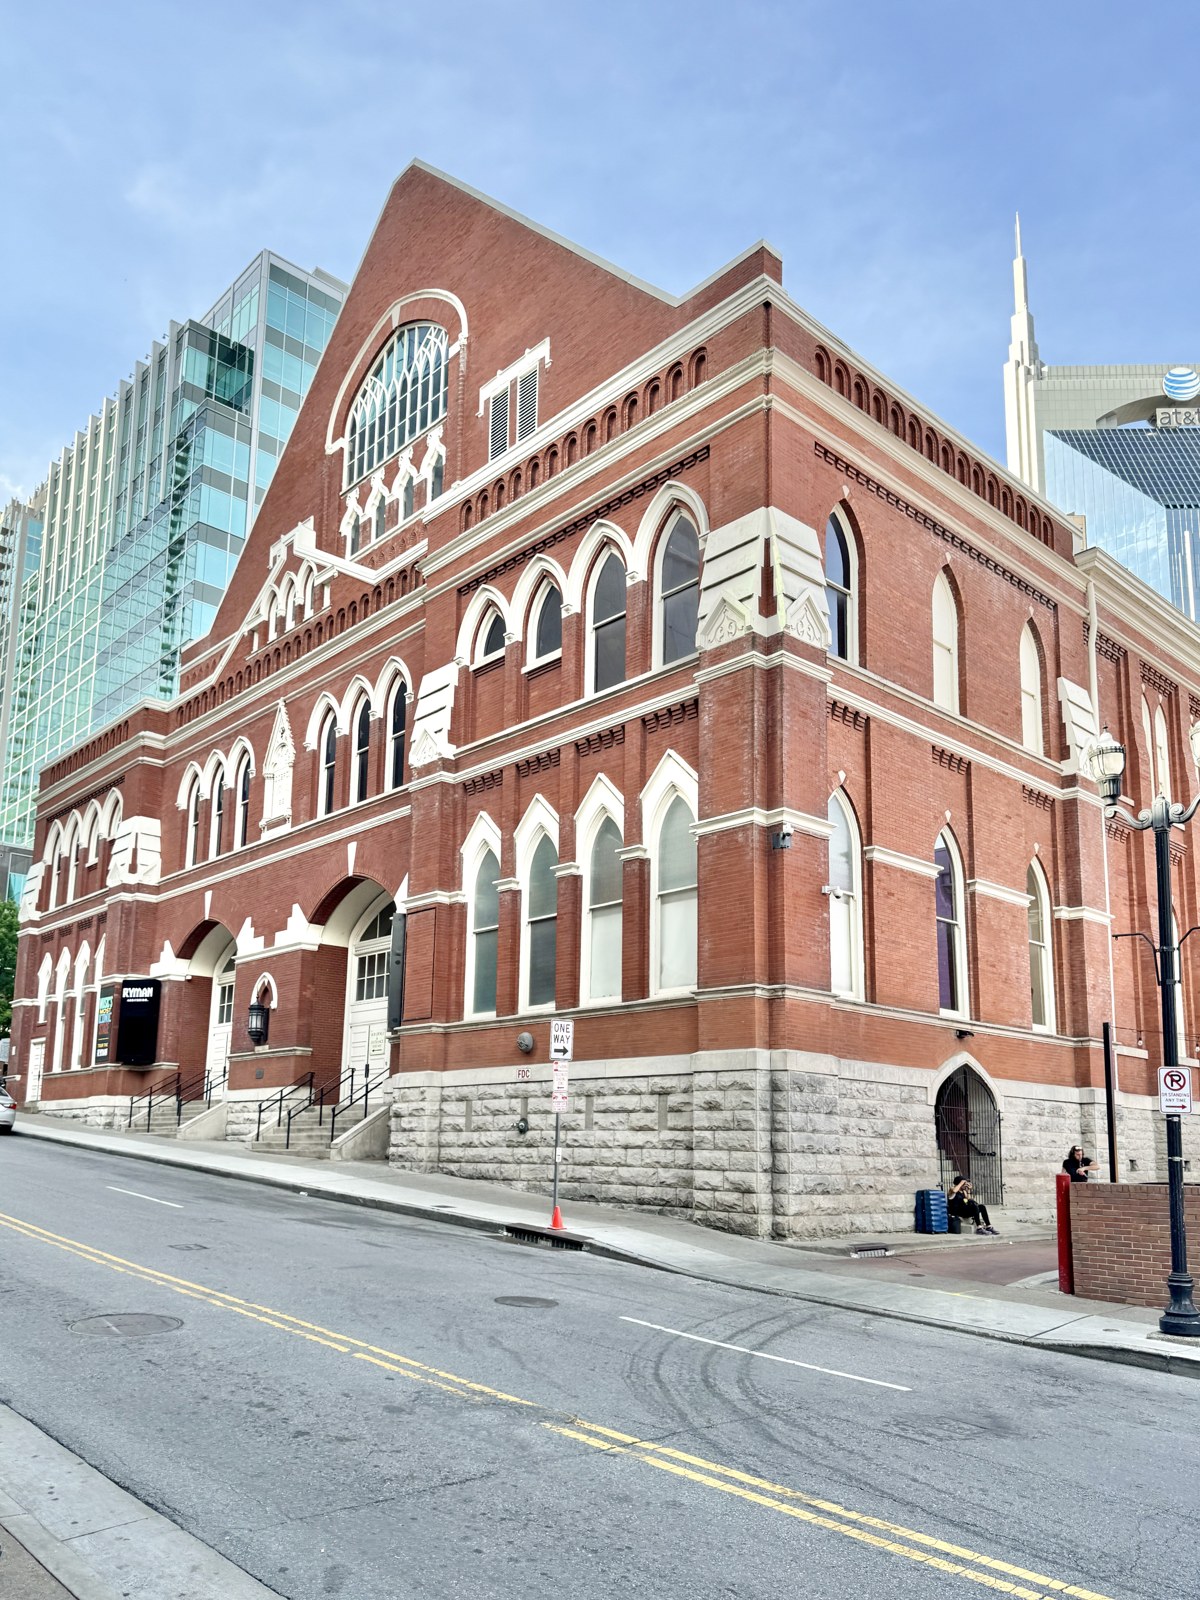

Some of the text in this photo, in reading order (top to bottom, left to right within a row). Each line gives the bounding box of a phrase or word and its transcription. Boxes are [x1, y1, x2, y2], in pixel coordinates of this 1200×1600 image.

[1159, 408, 1200, 426] at&t
[122, 987, 154, 998] RYMAN
[553, 1023, 571, 1033] ONE
[553, 1034, 571, 1044] WAY
[517, 1069, 531, 1079] FDC
